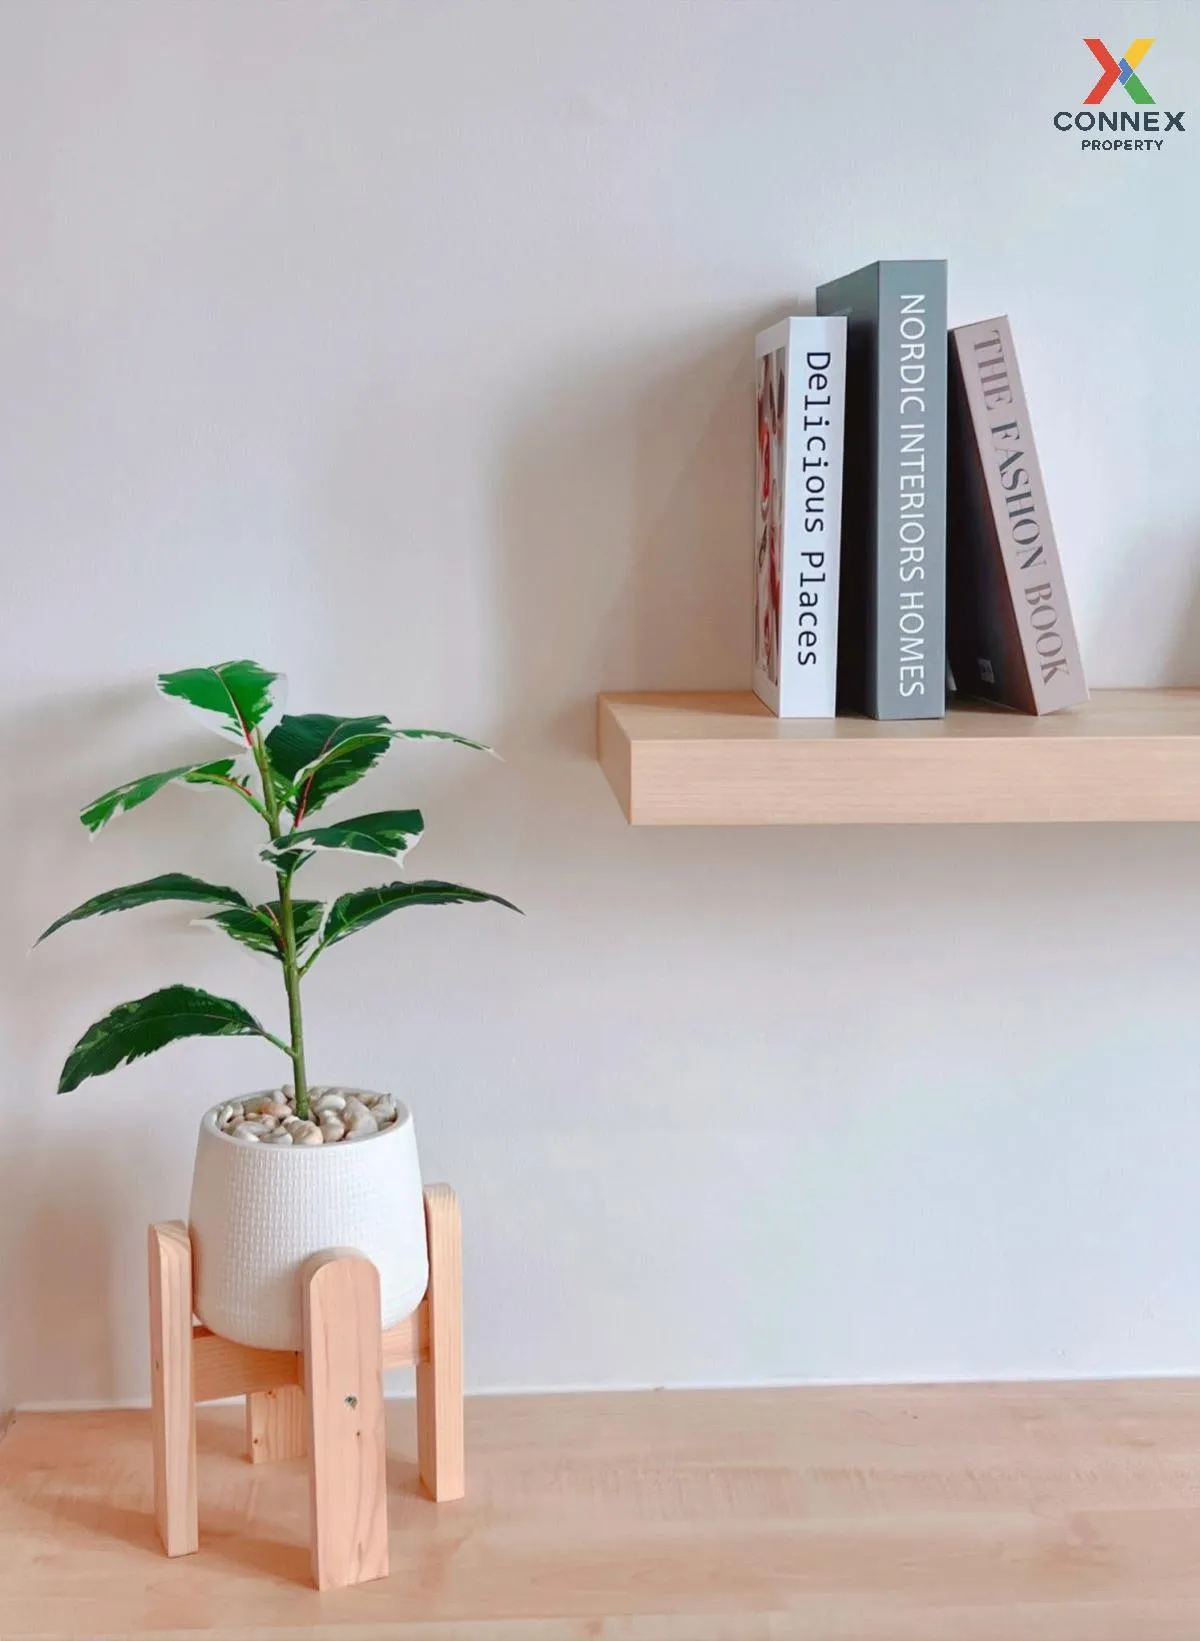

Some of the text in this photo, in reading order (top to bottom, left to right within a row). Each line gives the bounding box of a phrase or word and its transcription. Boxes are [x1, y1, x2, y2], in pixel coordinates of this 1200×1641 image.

[798, 351, 832, 666] Delicious Places
[899, 294, 926, 698] NORDIC INTERIORS HOMES
[973, 329, 1070, 685] THE FASHION BOOK
